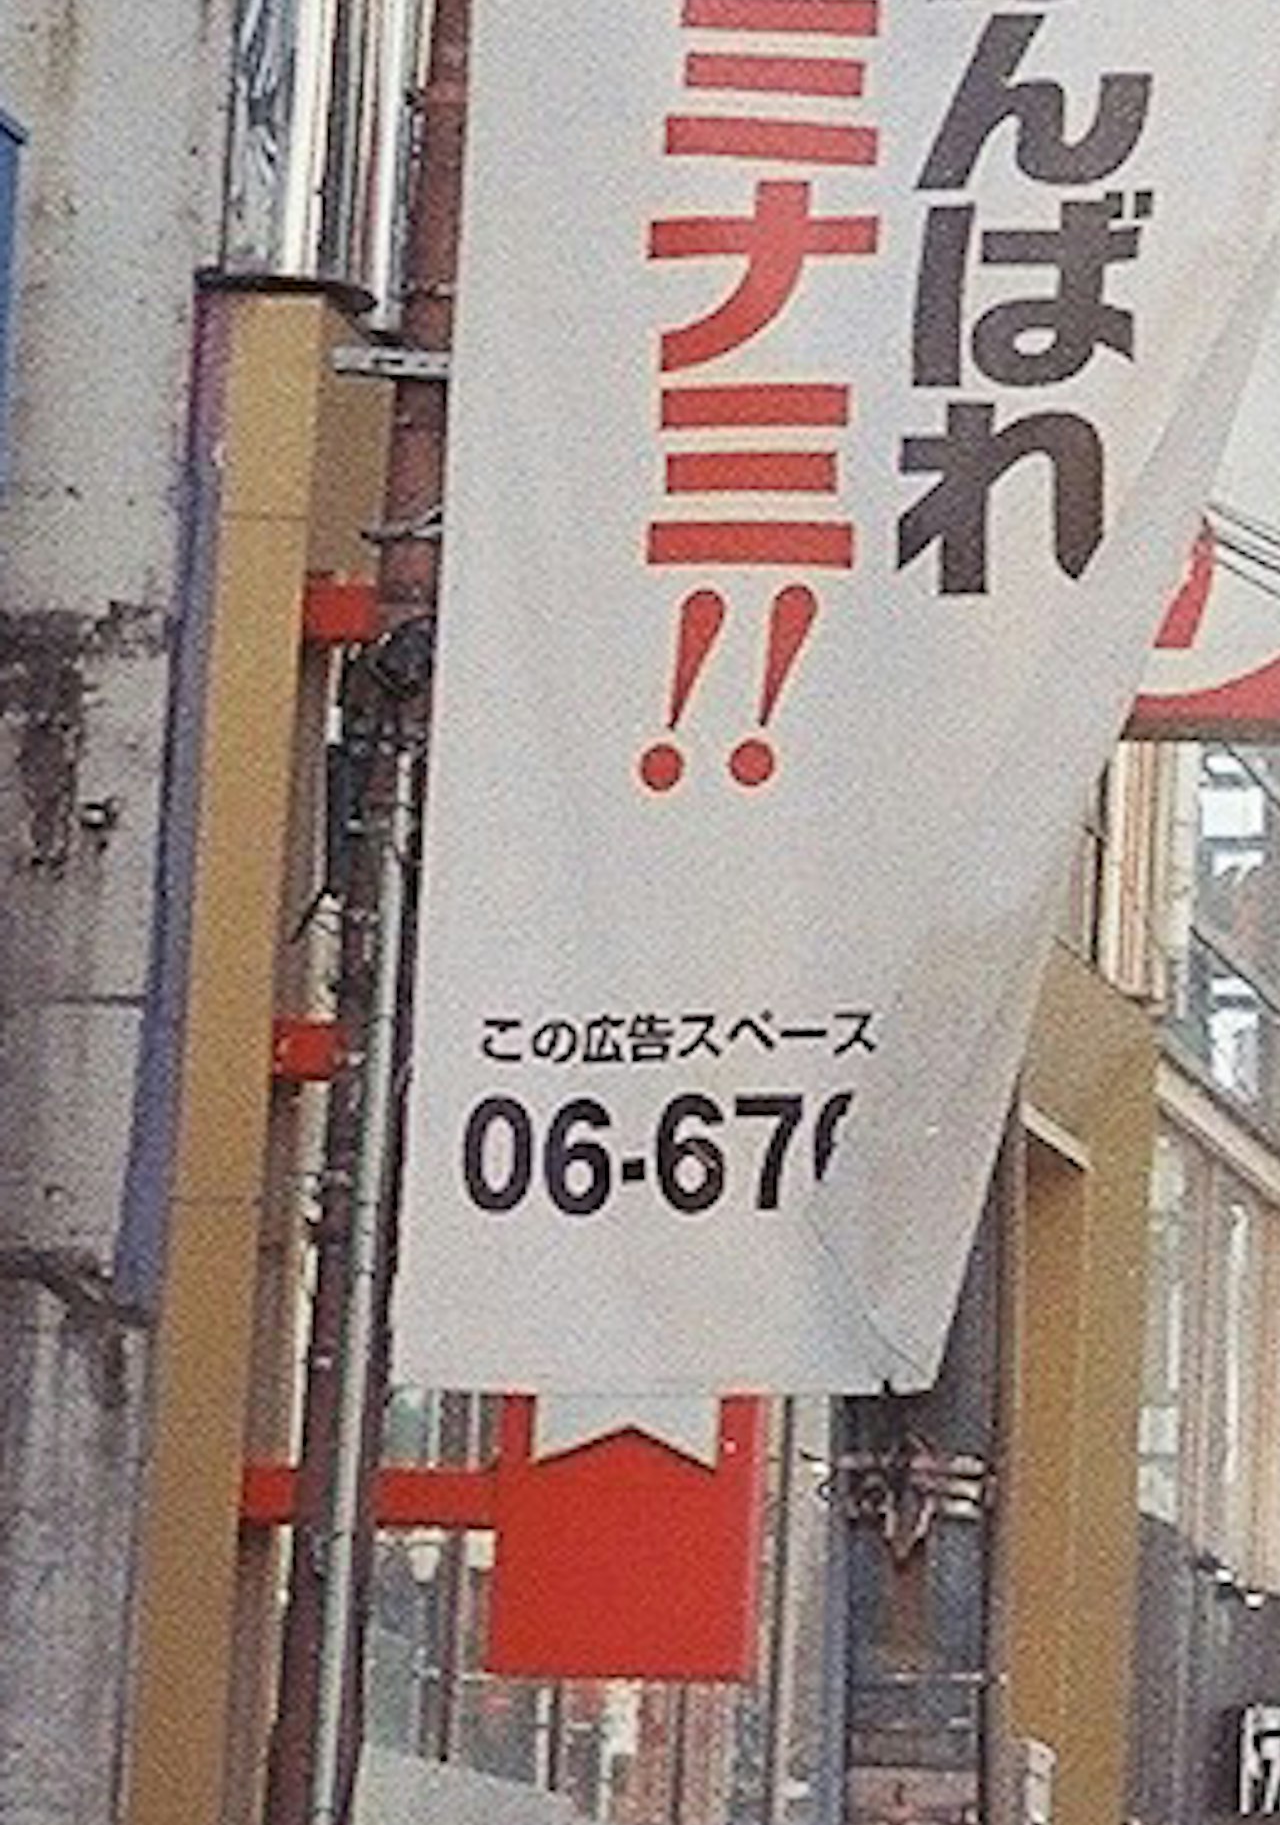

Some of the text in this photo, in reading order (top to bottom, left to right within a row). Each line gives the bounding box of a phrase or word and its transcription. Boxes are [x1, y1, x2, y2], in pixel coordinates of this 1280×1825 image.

[480, 1010, 878, 1064] この広告スペース
